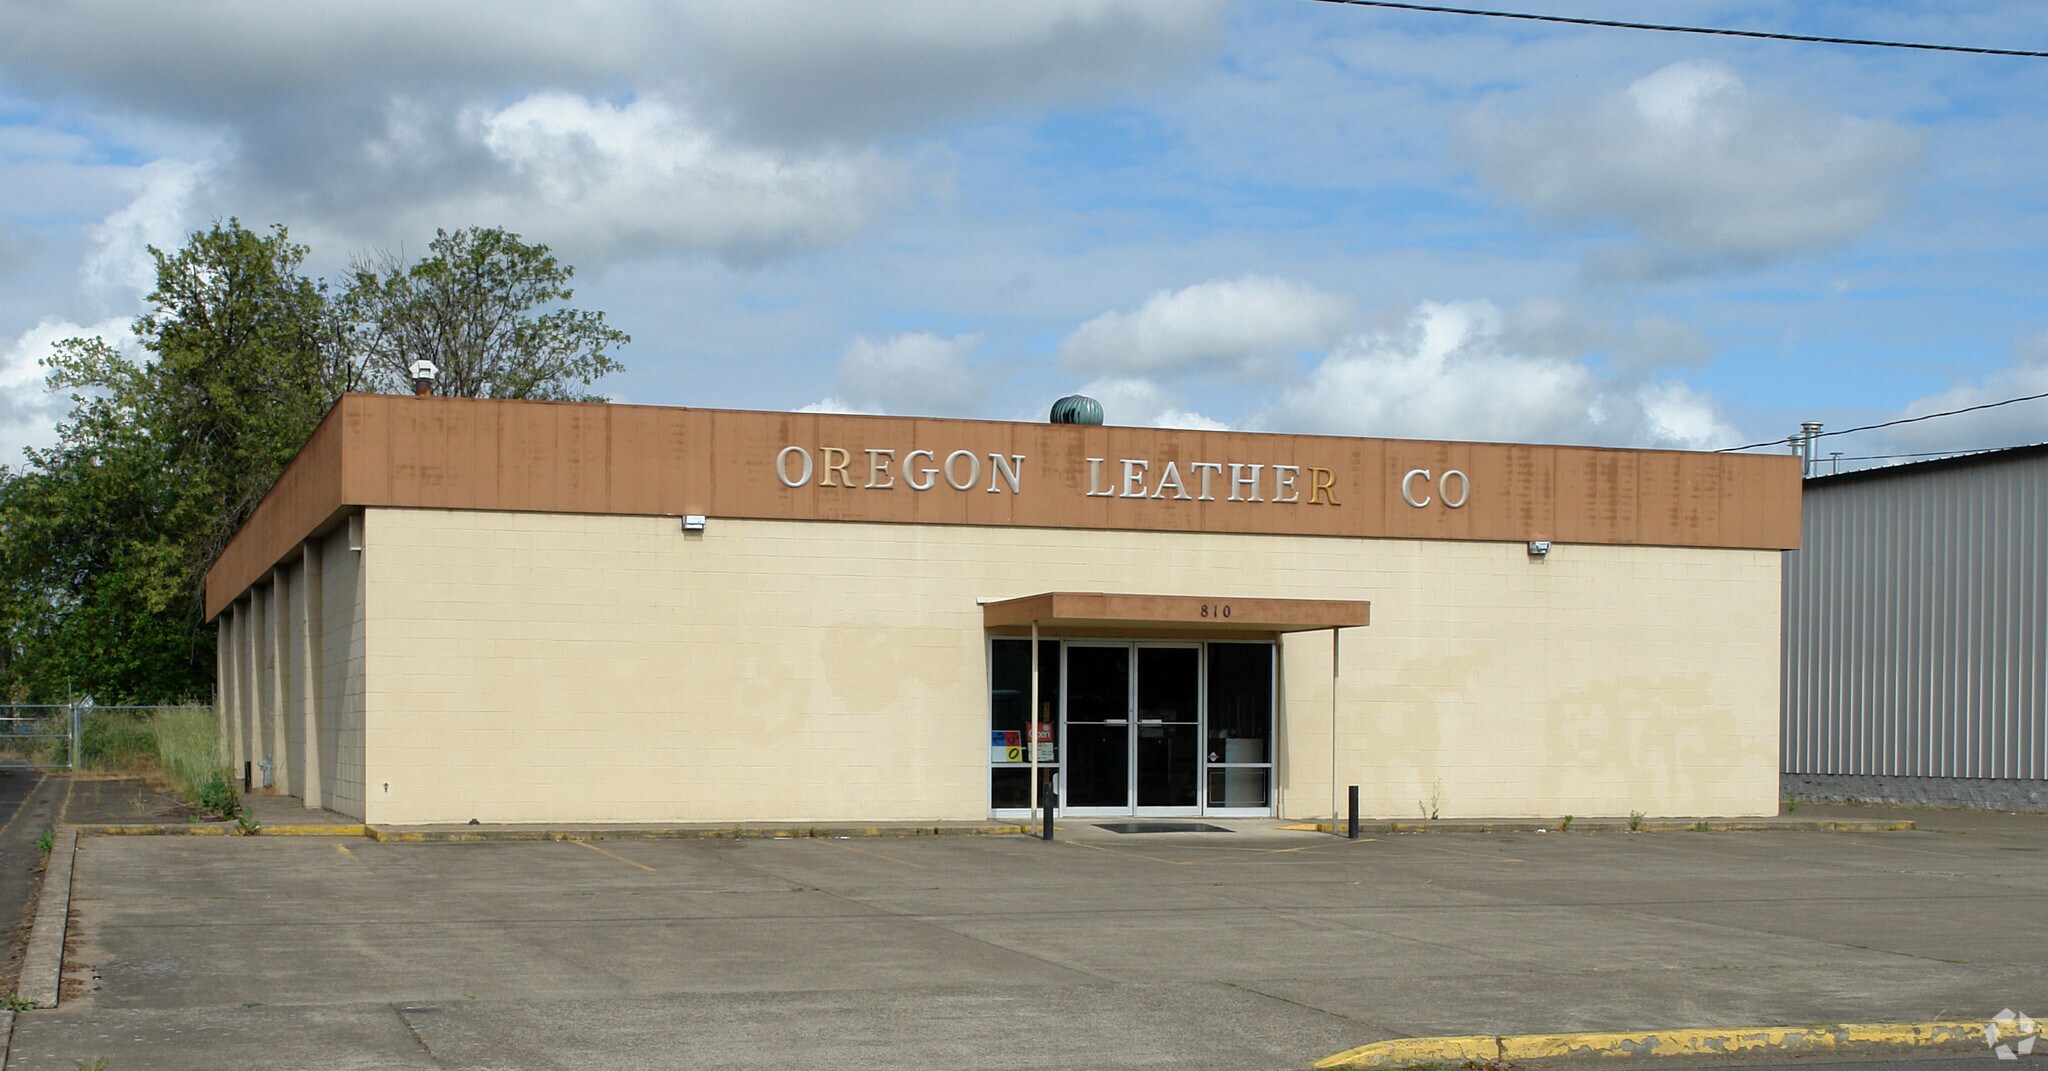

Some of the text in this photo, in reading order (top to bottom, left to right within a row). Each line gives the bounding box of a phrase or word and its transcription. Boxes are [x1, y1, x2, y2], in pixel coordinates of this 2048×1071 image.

[775, 445, 1471, 509] OREGON LEATHER CO
[1200, 604, 1231, 618] 810
